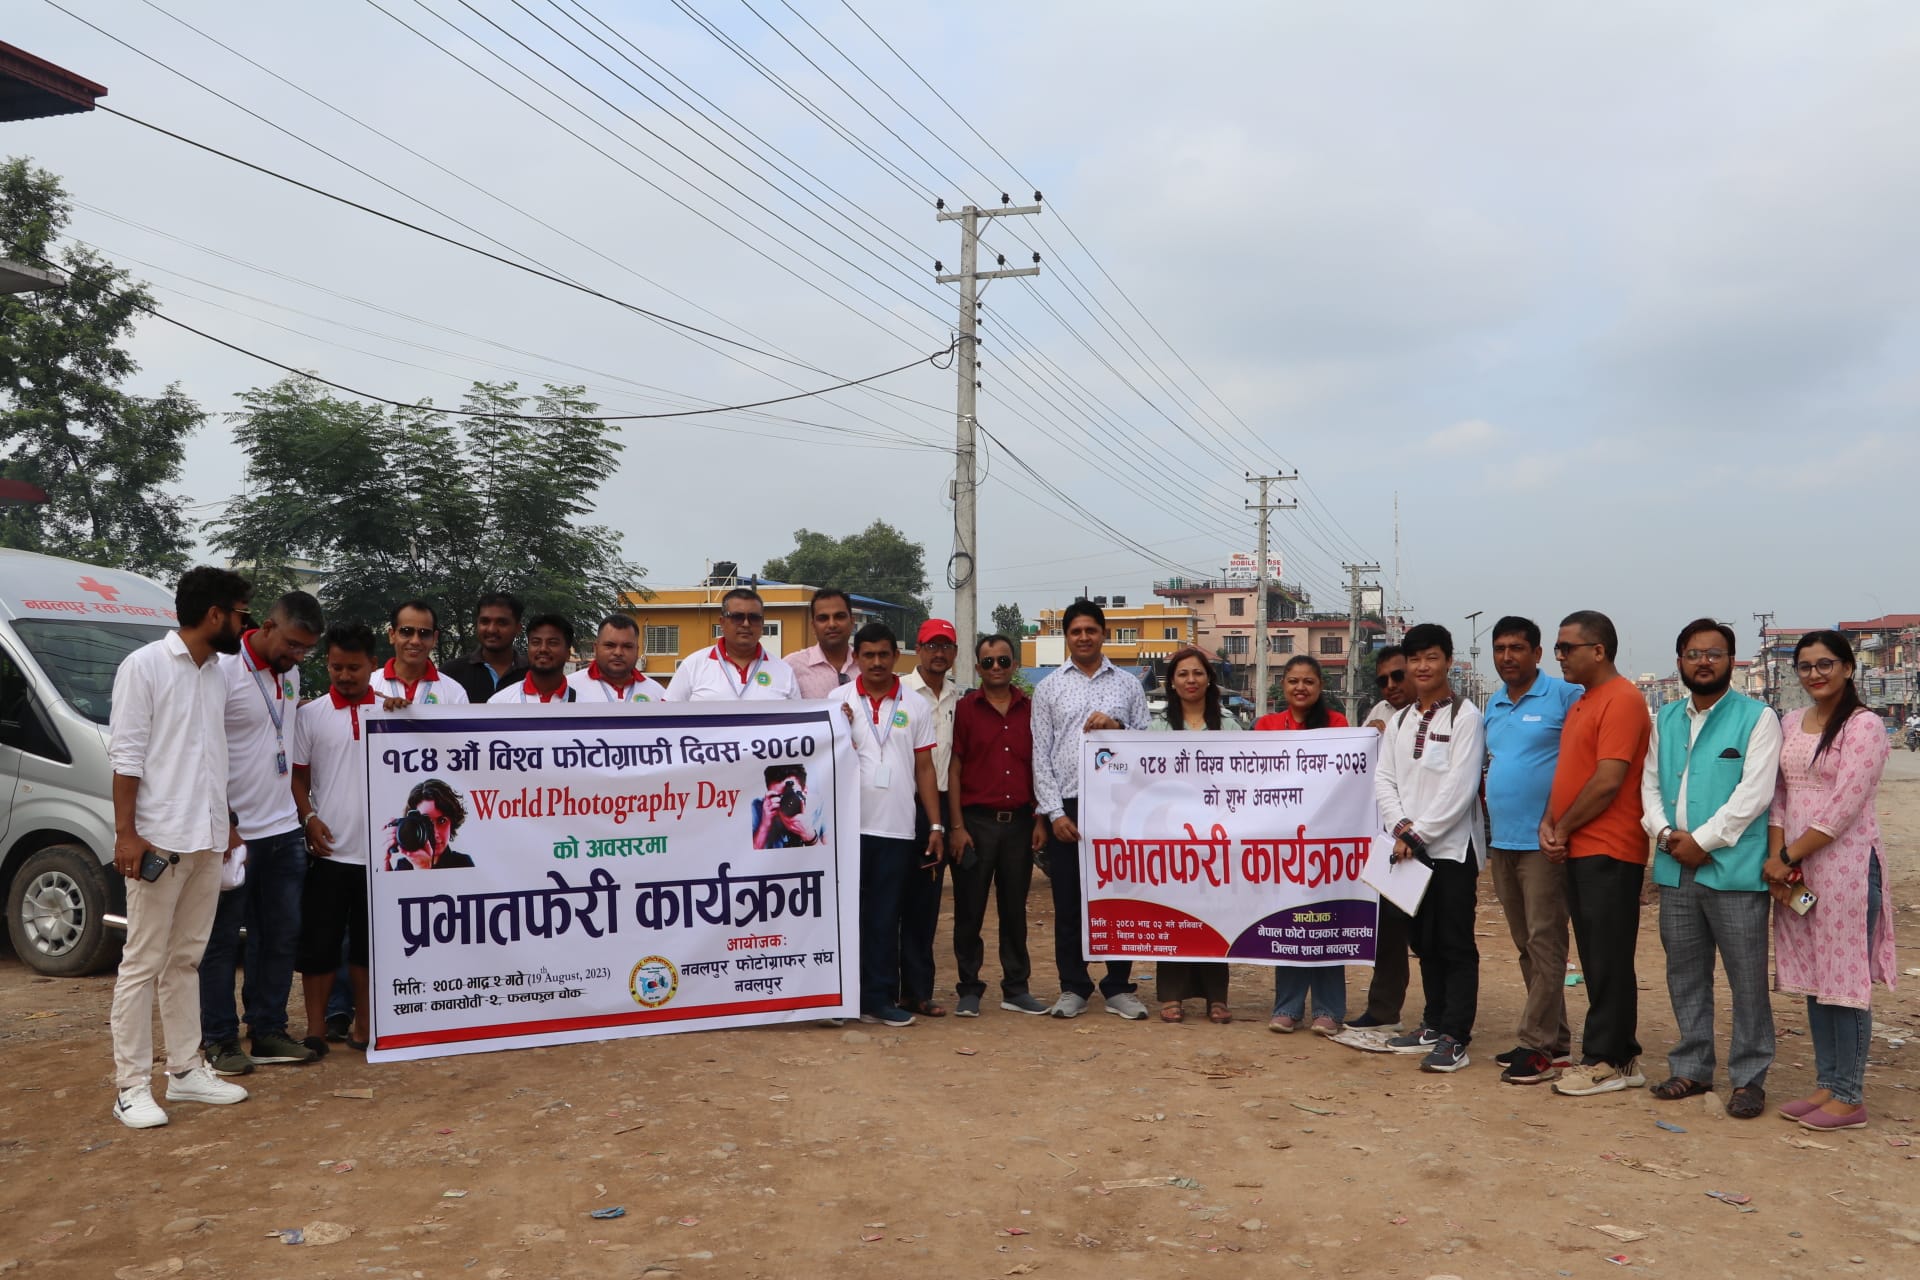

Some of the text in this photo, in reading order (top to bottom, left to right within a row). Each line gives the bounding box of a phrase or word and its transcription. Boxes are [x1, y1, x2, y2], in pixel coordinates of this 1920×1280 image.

[21, 599, 90, 615] नवलपुर
[382, 747, 438, 773] १८४
[489, 739, 544, 772] विश्व
[552, 737, 673, 770] फोटोग्राफी
[1140, 756, 1167, 775] १८४
[1195, 749, 1225, 775] विश्व
[1230, 749, 1292, 775] फोटोग्राफी
[470, 781, 741, 824] World Photography Day
[1203, 784, 1304, 813] को शुभ अवसरमा
[553, 835, 669, 859] को अवसरमा
[1092, 822, 1372, 890] प्रभातफेरी कार्यक्रम
[397, 862, 825, 957] प्रभातफेरी कार्यक्रम
[1292, 910, 1332, 923] आयोजक
[1258, 924, 1374, 940] नेपाल फोटो पत्रकार महासंघ
[1271, 940, 1360, 956] जिल्ला शाखा नवलपुर
[681, 959, 730, 979] नवलपुर
[735, 953, 807, 971] फोटोग्राफर
[812, 949, 835, 966] संघ
[433, 978, 463, 993] २०८०
[505, 971, 526, 987] गते
[545, 972, 583, 986] August,
[585, 967, 611, 981] 2023)
[734, 976, 784, 995] नवलपुर
[431, 994, 482, 1012] कावासोती
[558, 987, 583, 999] चोक
